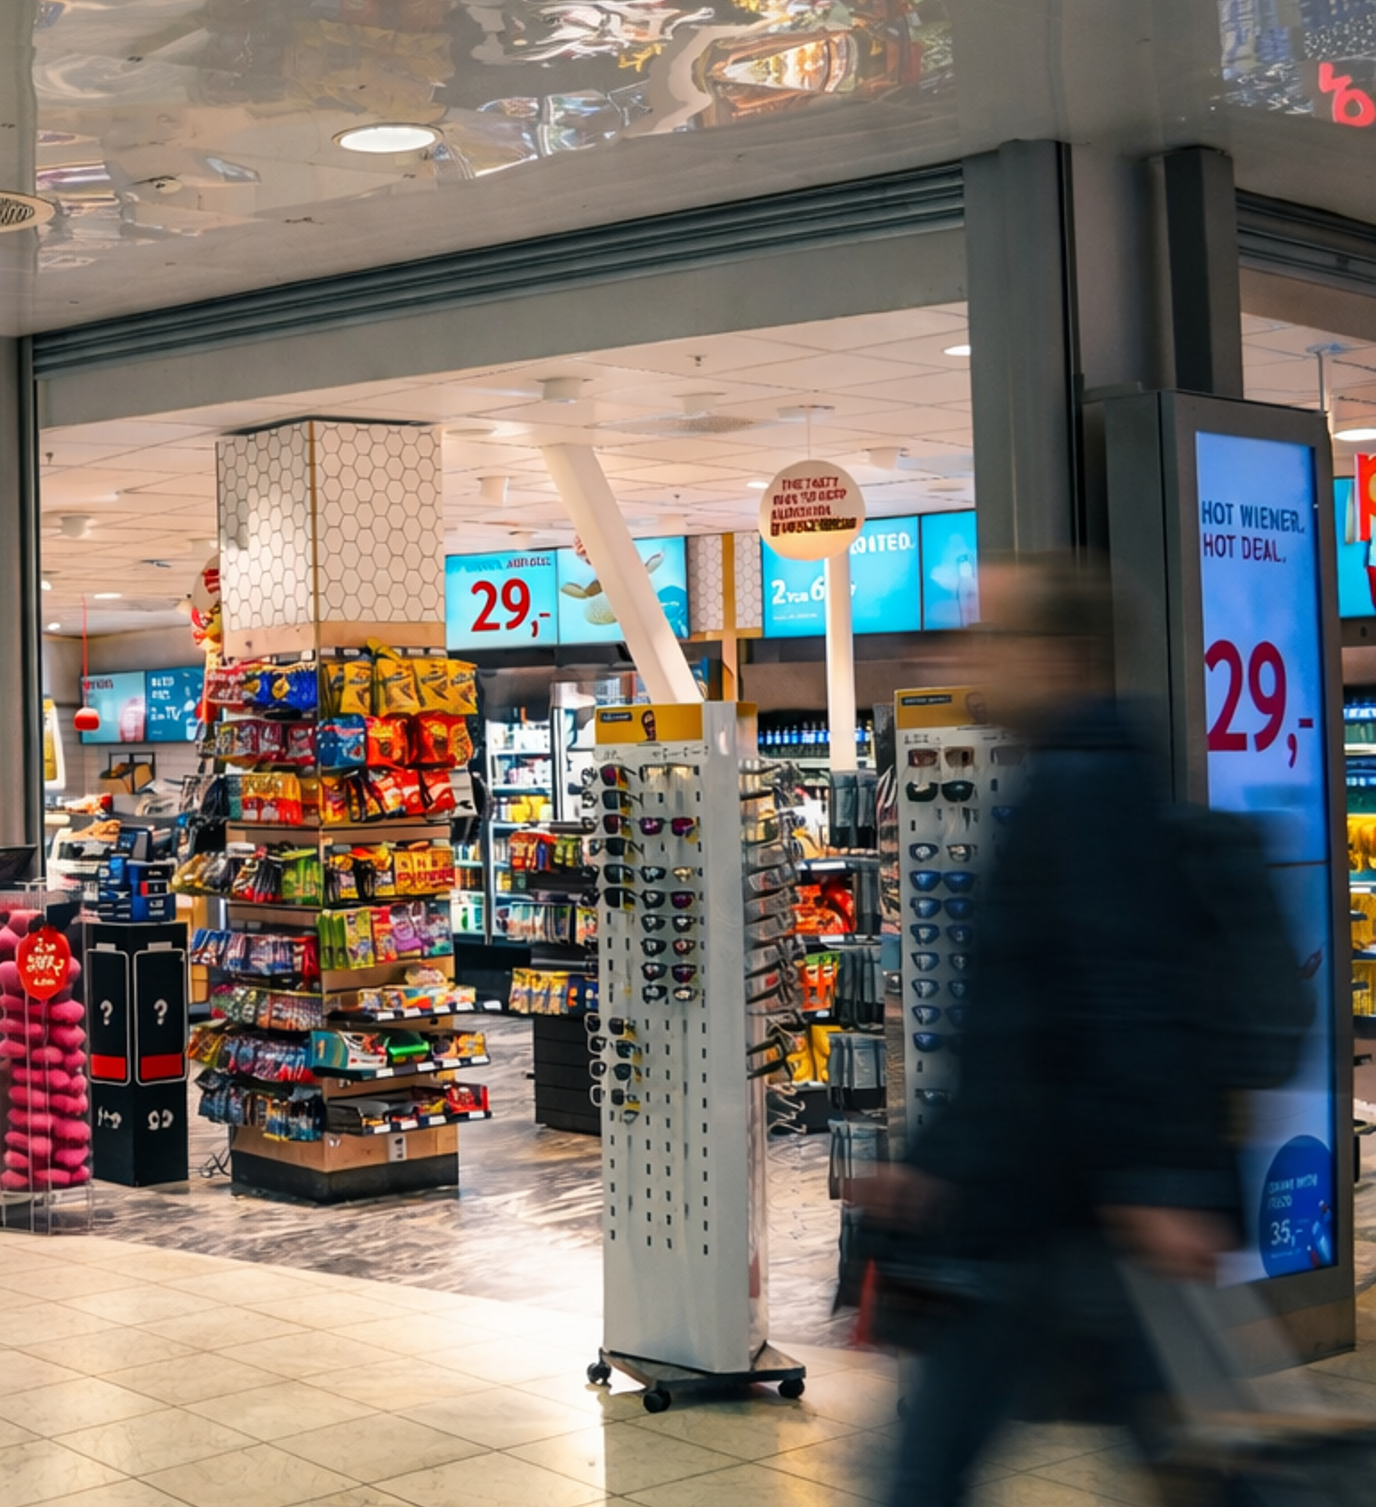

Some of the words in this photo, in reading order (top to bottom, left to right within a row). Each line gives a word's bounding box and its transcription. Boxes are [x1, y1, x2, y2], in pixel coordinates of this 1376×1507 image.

[1201, 501, 1234, 527] HOT
[1240, 504, 1306, 535] WIENER.
[1203, 533, 1237, 557] HOT
[1241, 535, 1288, 564] DEAL.
[470, 578, 551, 638] 29,-
[1204, 639, 1314, 769] 29,-
